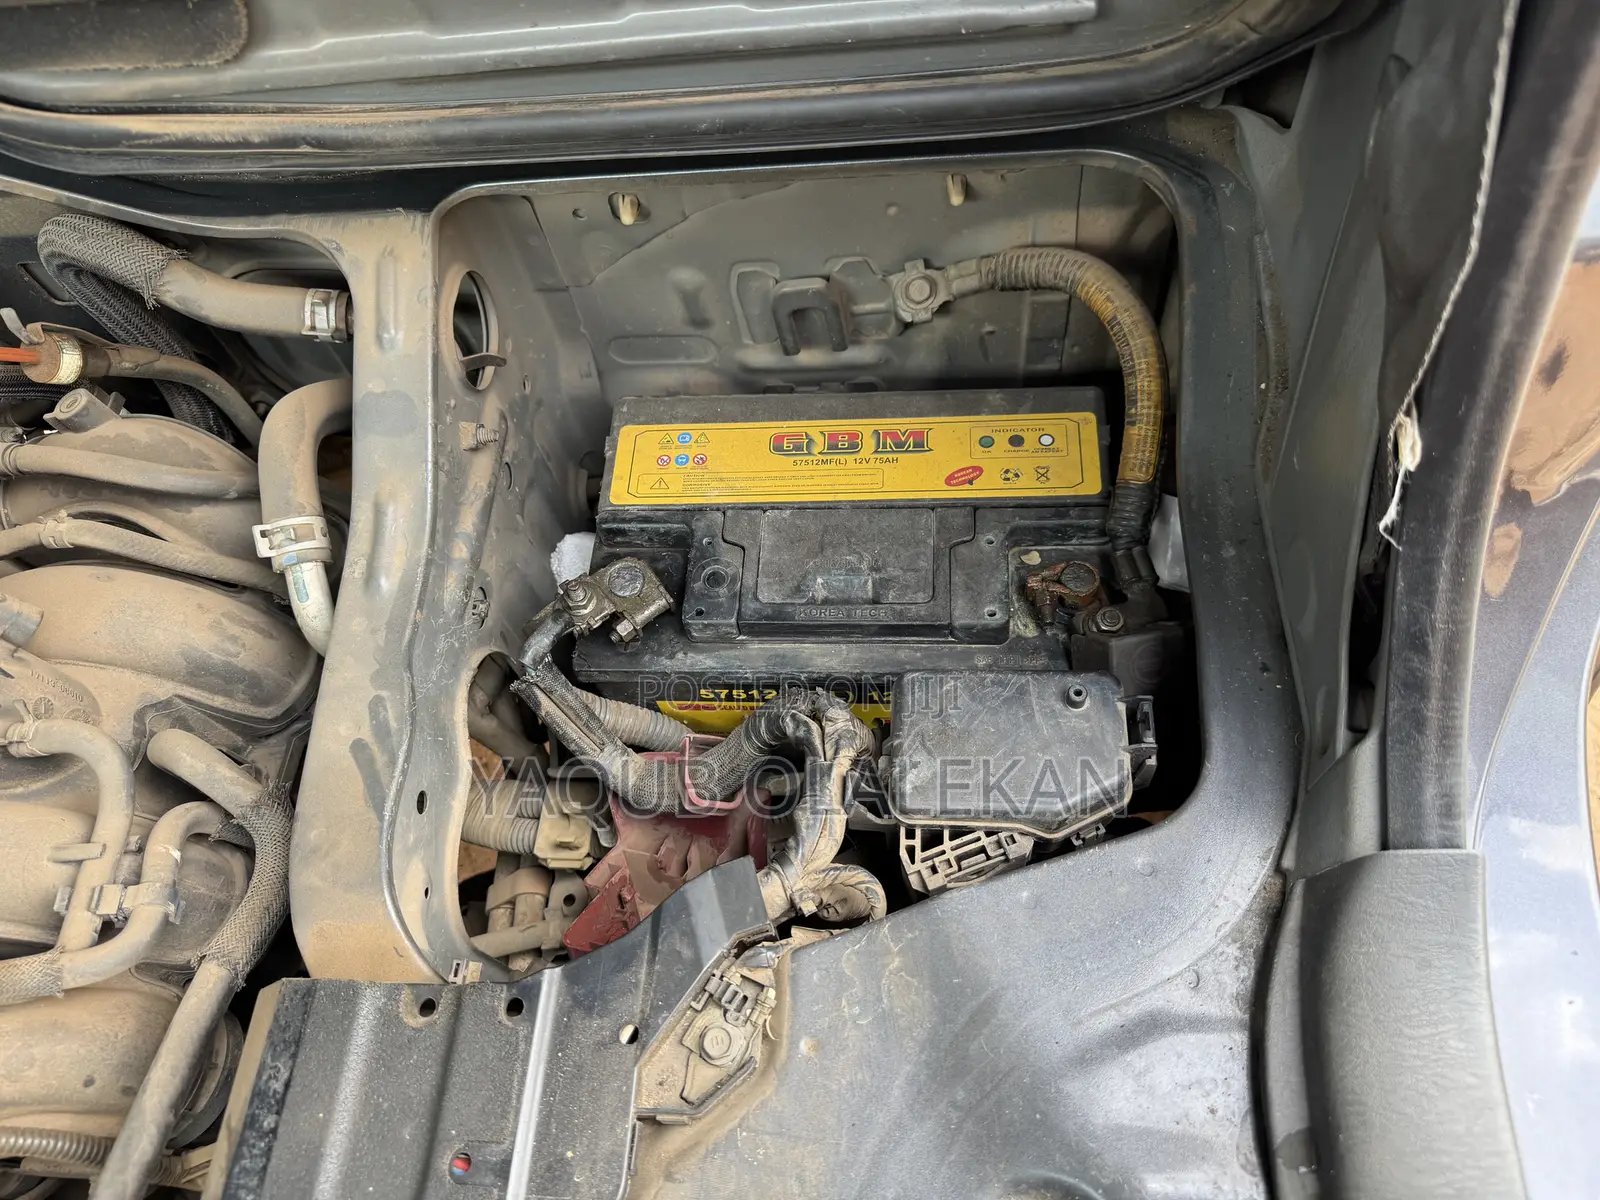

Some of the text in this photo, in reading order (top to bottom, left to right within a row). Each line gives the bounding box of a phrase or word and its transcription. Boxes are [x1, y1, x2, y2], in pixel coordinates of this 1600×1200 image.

[769, 428, 934, 456] GBM
[792, 456, 899, 467] 57512MF(L) 12V 75AH
[950, 471, 980, 485] TECHNOLOGY
[954, 468, 973, 478] KOREAN
[800, 608, 888, 617] KOREA TECH
